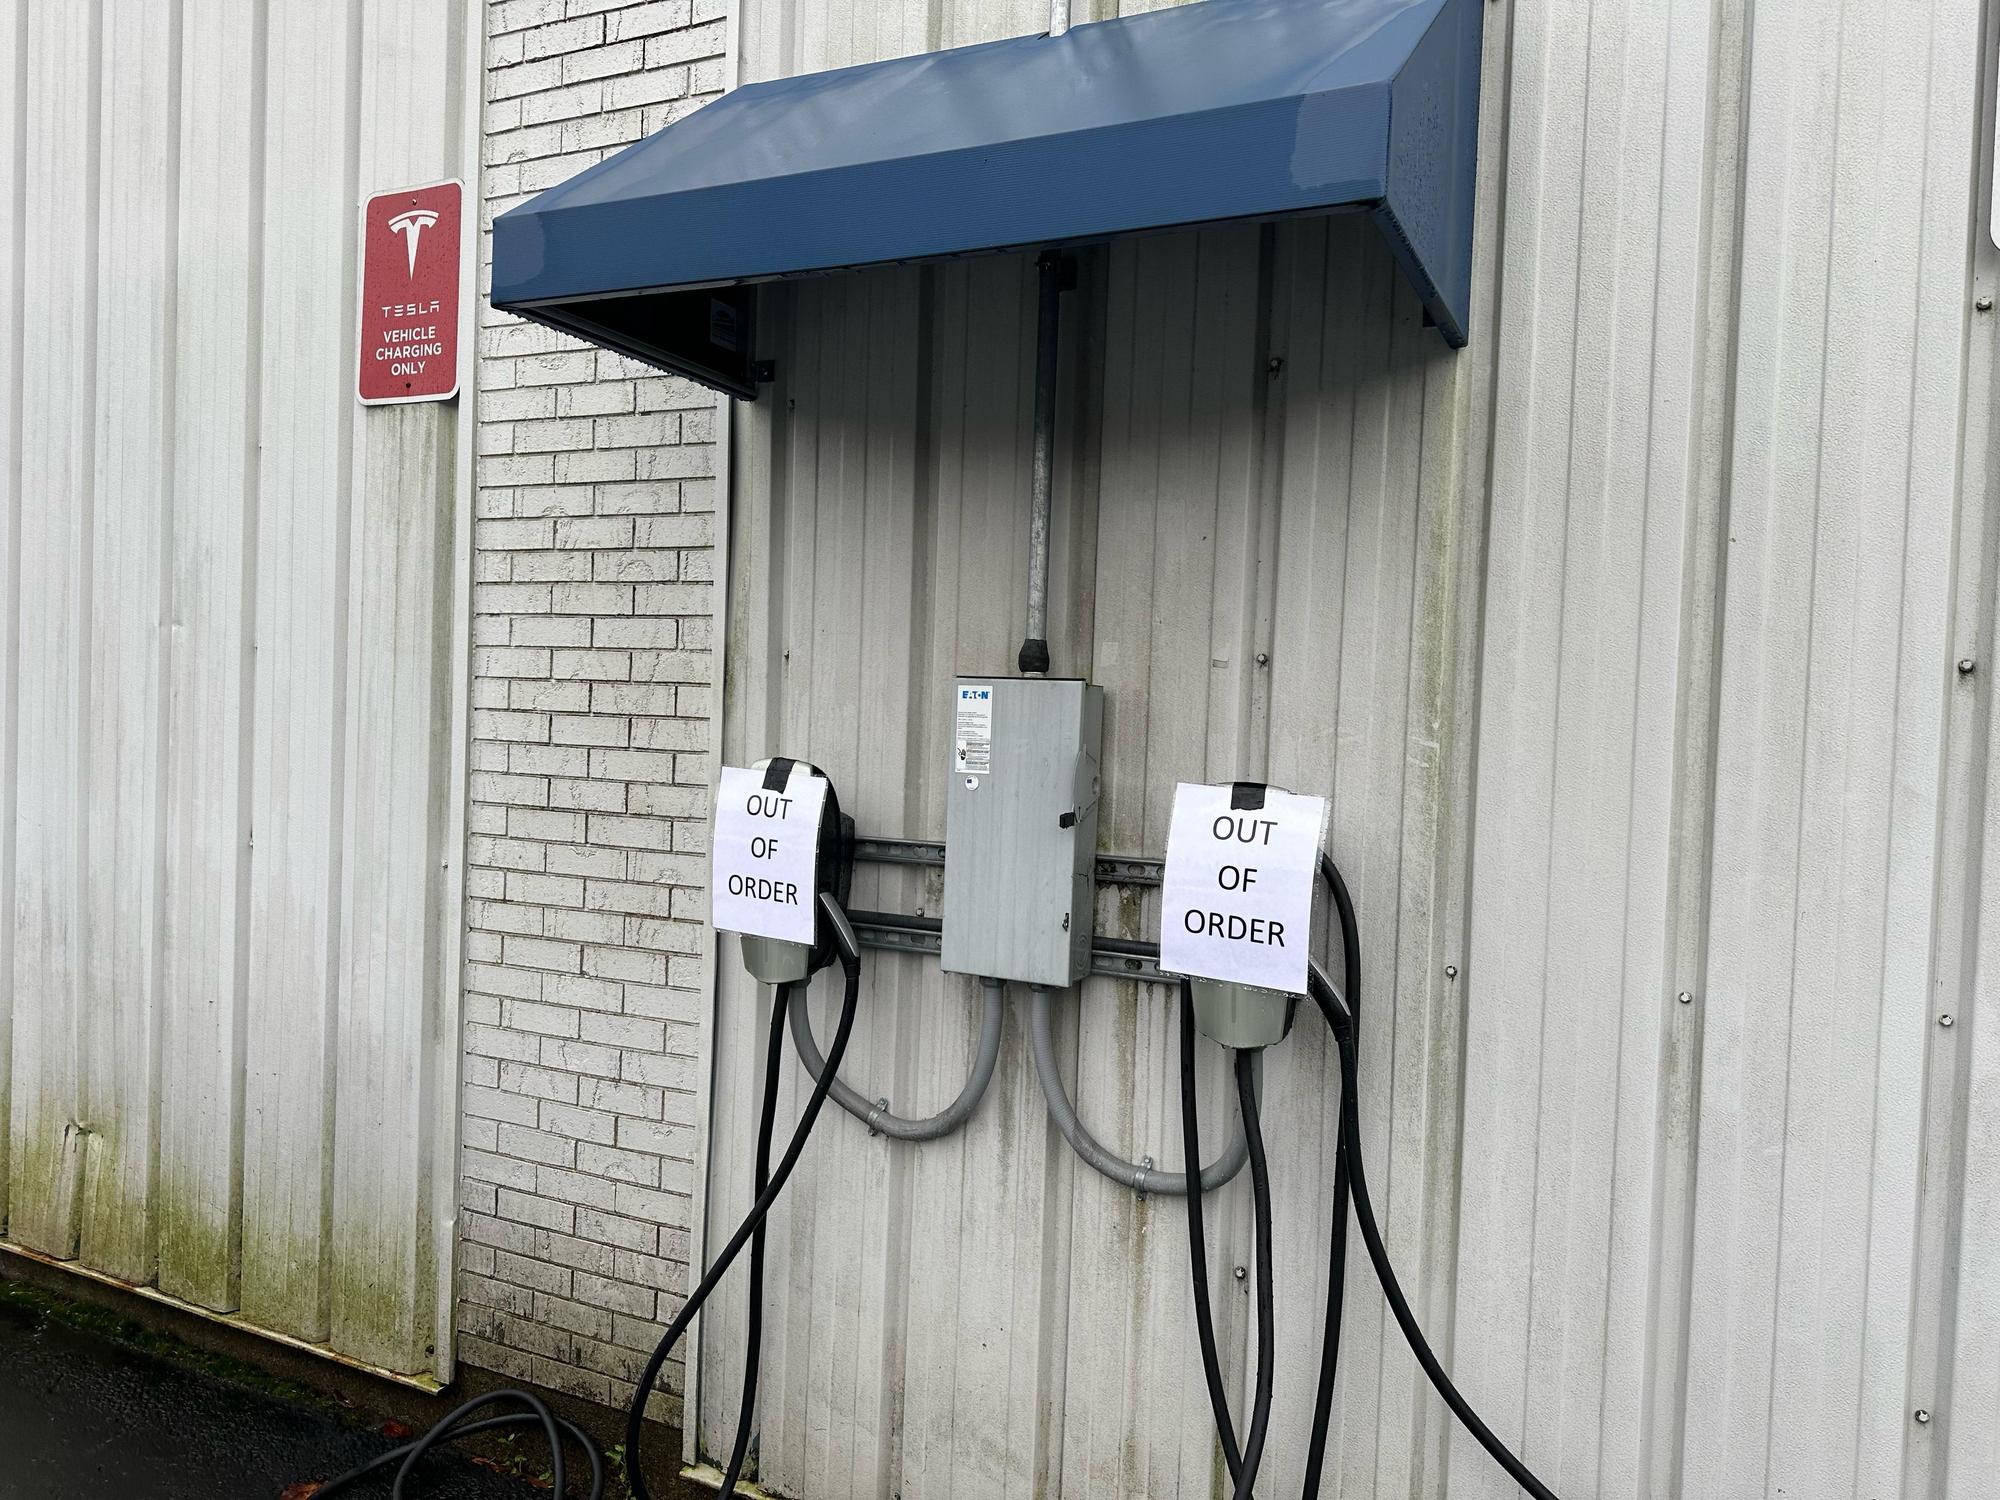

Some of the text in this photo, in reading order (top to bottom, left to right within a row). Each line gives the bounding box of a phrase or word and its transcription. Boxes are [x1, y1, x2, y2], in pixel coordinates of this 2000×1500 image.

[381, 301, 440, 318] TESLA
[383, 326, 436, 343] VEHICLE
[376, 342, 442, 360] CHARGING
[391, 361, 426, 376] ONLY
[747, 795, 792, 820] OUT
[1213, 816, 1277, 846] OUT
[752, 837, 778, 860] OF
[729, 875, 798, 906] ORDER
[1219, 865, 1257, 893] OF
[1184, 909, 1285, 948] ORDER
